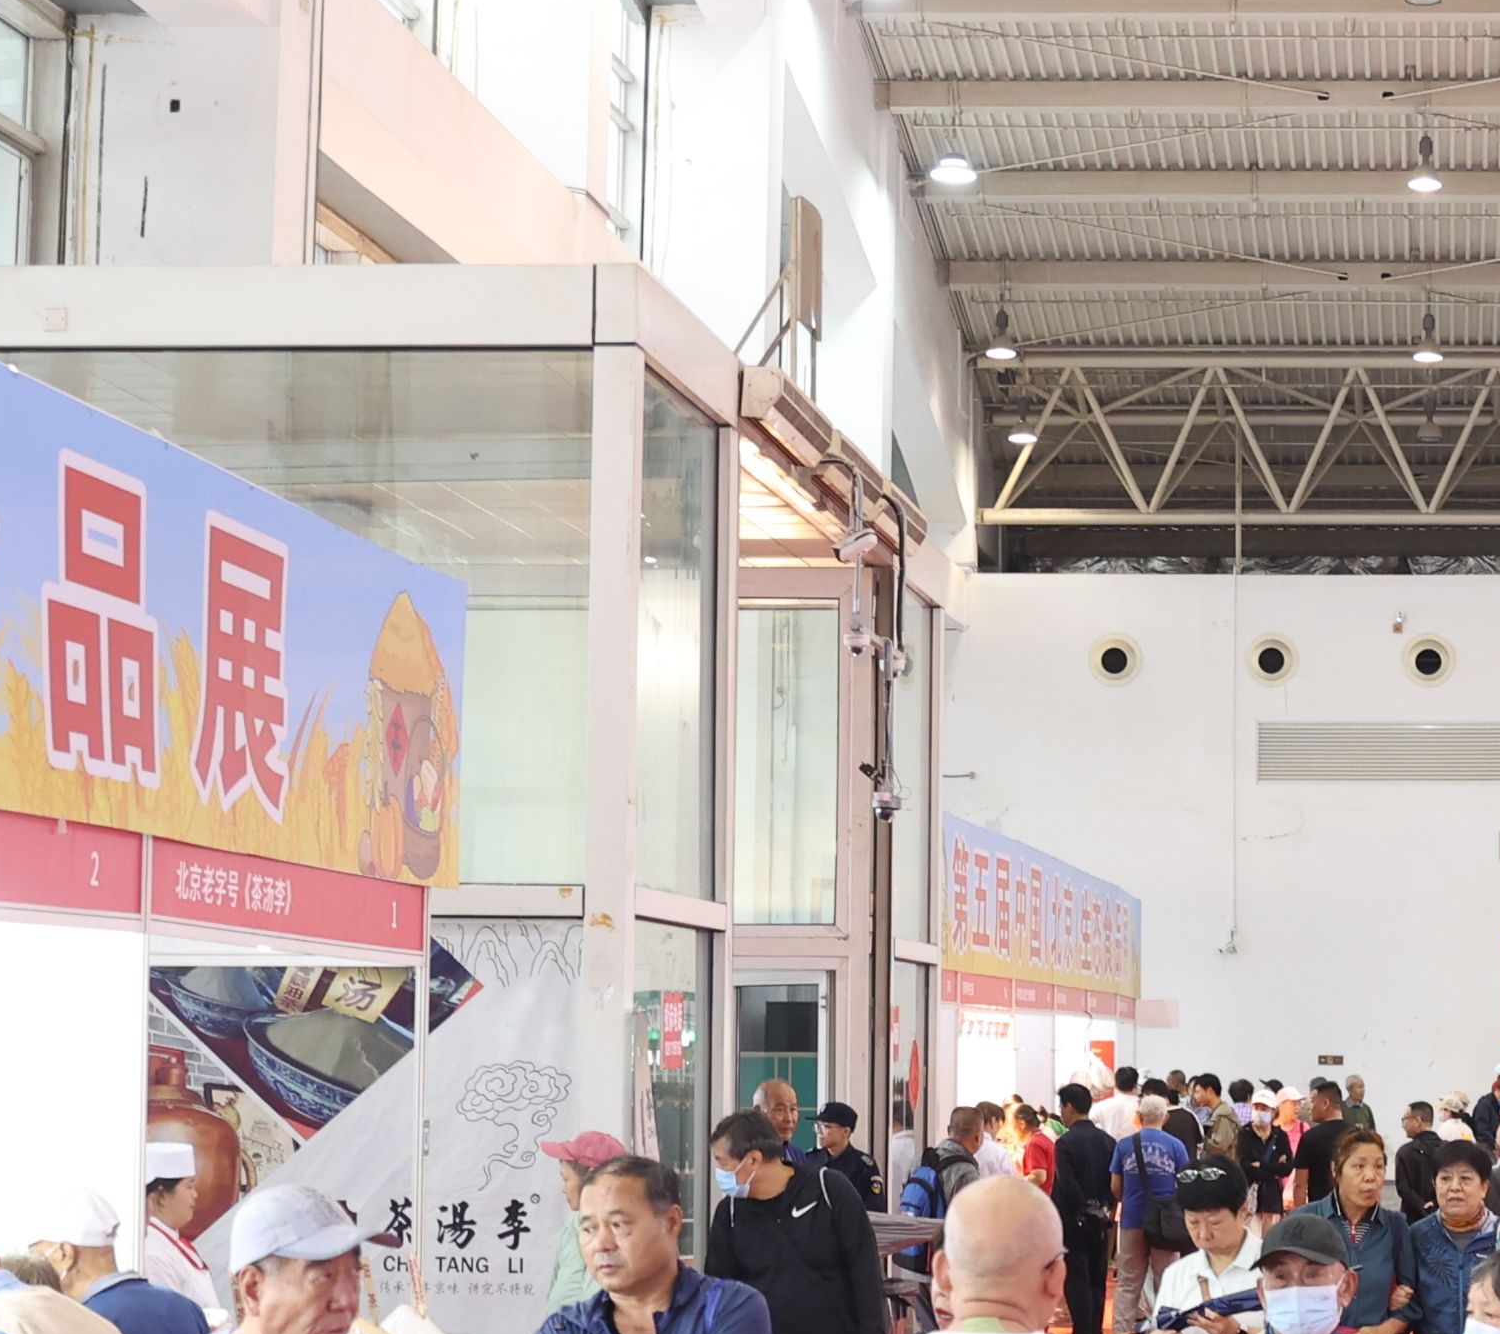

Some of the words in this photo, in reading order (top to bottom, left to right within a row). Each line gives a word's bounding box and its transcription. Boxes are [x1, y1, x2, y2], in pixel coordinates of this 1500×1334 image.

[90, 851, 100, 886] 2
[390, 900, 398, 929] 1
[383, 1256, 410, 1272] CH
[435, 1256, 489, 1273] TANG
[508, 1257, 524, 1274] LI
[379, 1282, 460, 1295] 传承京味
